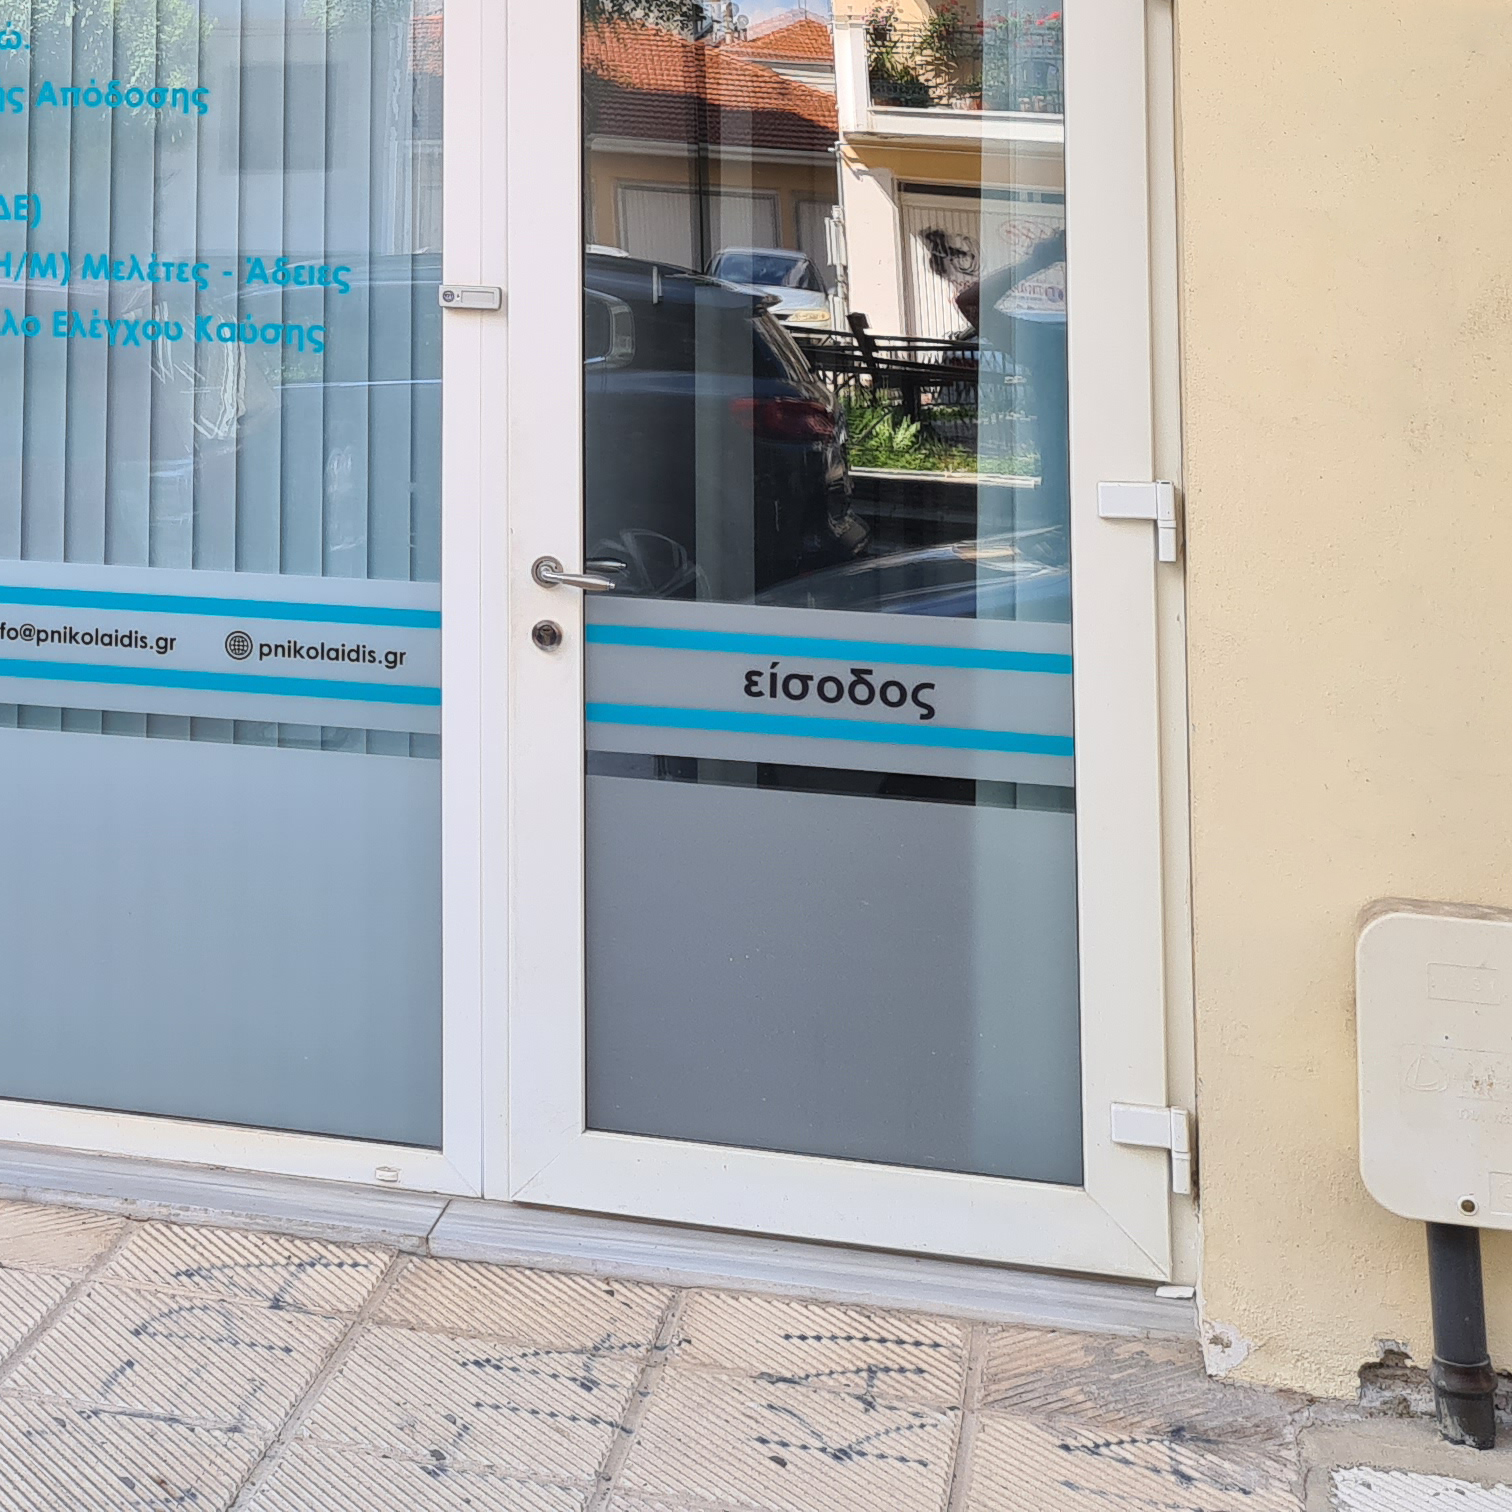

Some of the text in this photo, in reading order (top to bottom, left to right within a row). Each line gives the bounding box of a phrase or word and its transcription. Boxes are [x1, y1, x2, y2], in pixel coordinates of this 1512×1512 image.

[35, 79, 210, 116] Απόδοσης
[81, 252, 210, 291] Μελέτες
[245, 255, 352, 295] Άδειες
[52, 309, 184, 347] Ελέγχου
[194, 313, 327, 355] Καύσης
[259, 639, 407, 669] pnikolaidis.gr
[743, 661, 936, 721] είσοδος
